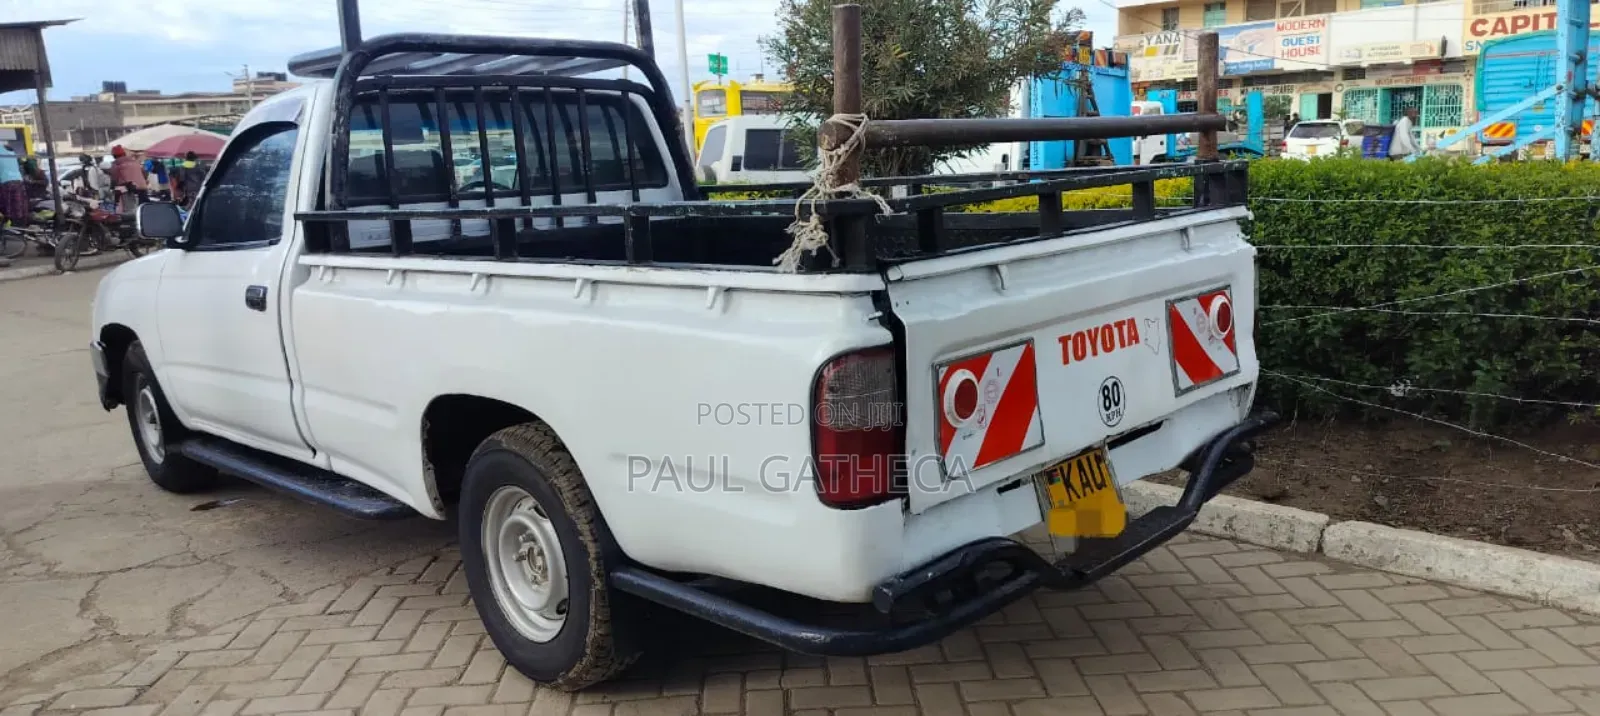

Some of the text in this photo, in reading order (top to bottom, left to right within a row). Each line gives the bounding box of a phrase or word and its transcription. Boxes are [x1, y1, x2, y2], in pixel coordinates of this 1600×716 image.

[1276, 18, 1326, 32] MODERN
[1144, 32, 1181, 45] YANA
[1281, 35, 1320, 47] GUEST
[1280, 46, 1321, 59] HOUSE
[1058, 317, 1140, 365] TOYOTA
[1102, 381, 1121, 412] 80
[1105, 407, 1122, 422] KPH
